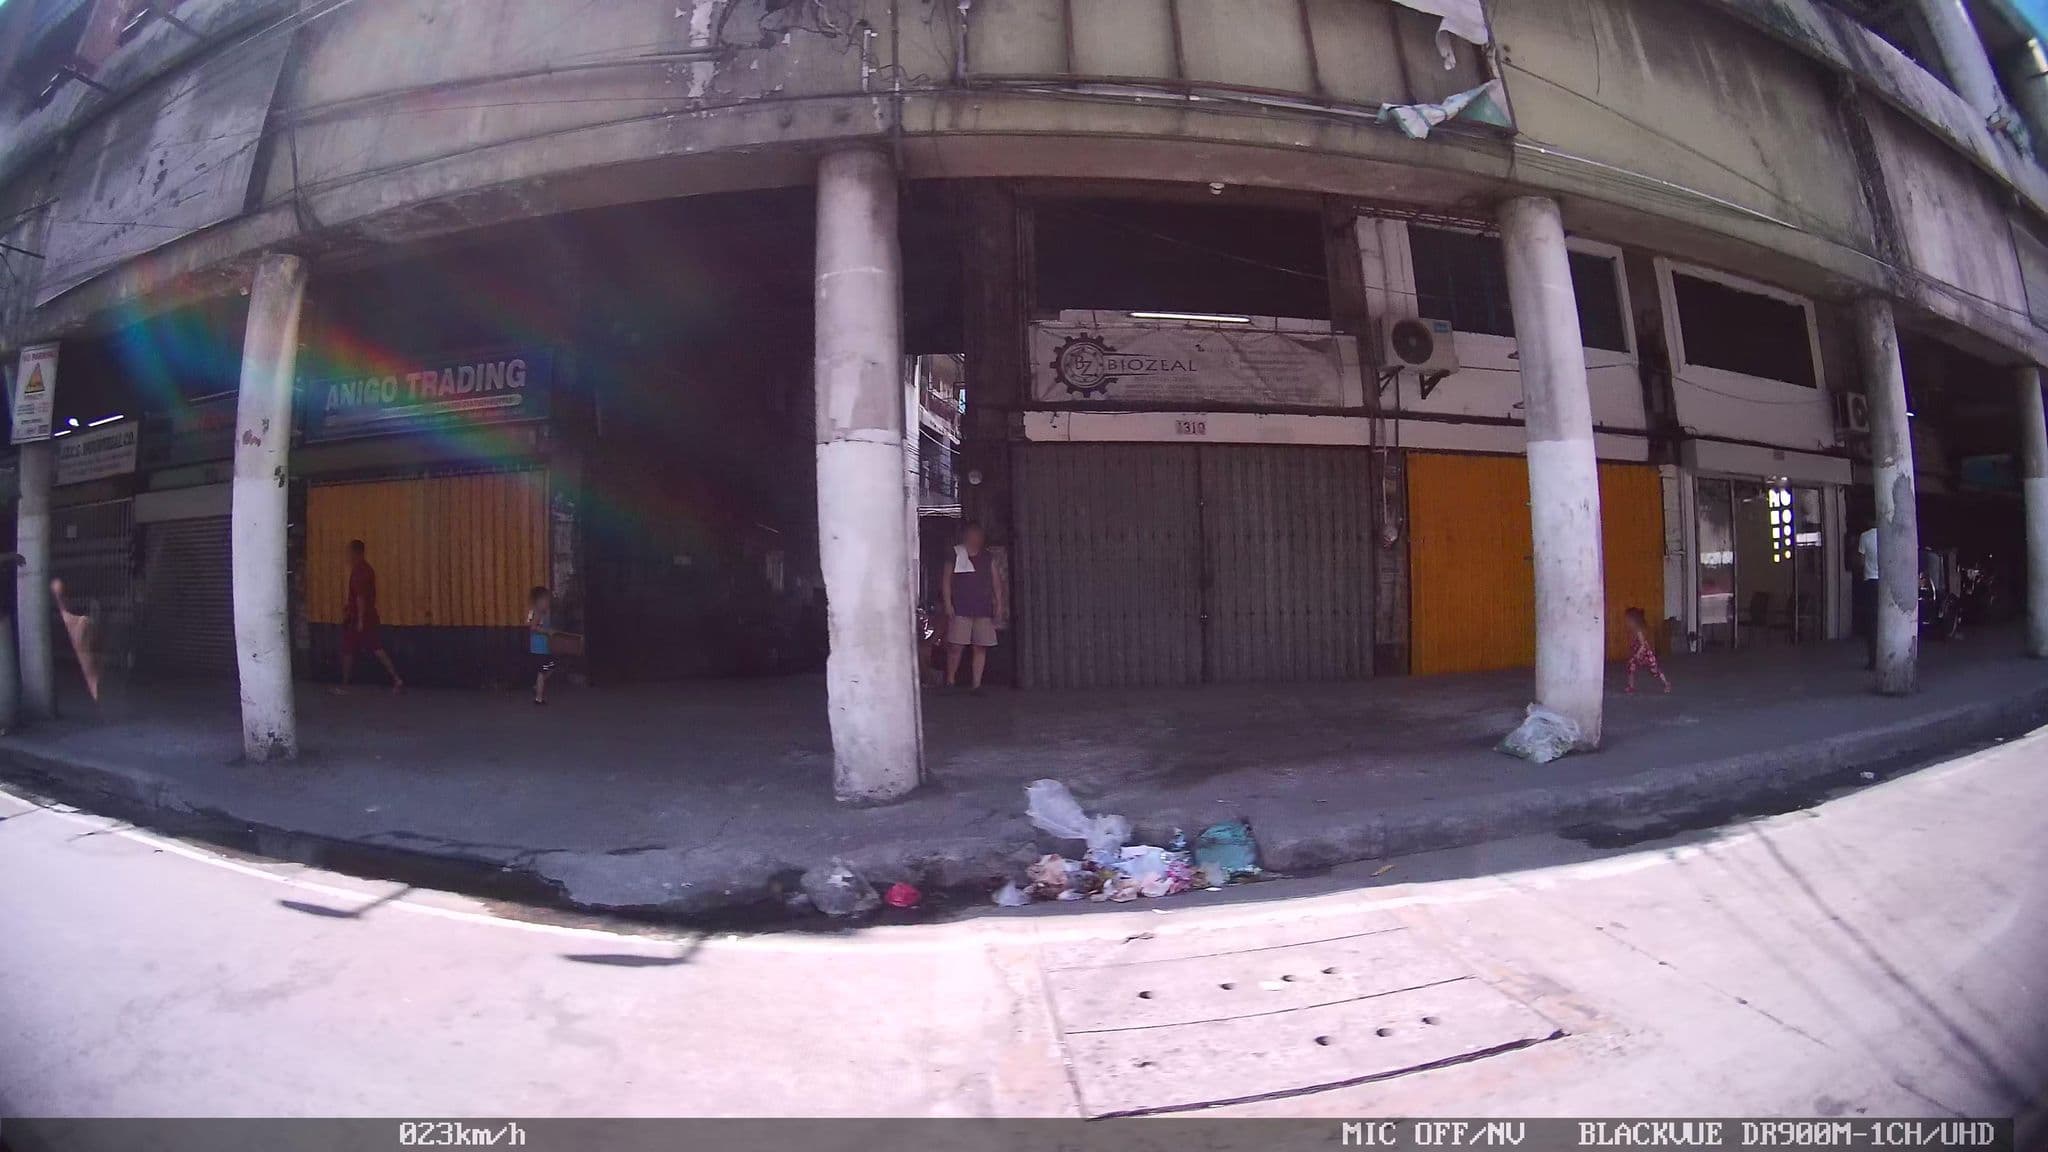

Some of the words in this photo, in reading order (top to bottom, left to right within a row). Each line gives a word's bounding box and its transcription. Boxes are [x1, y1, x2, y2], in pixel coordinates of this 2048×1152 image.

[1107, 358, 1198, 373] BIOZEAL
[326, 375, 398, 410] ANIGO
[406, 358, 527, 398] TRADING
